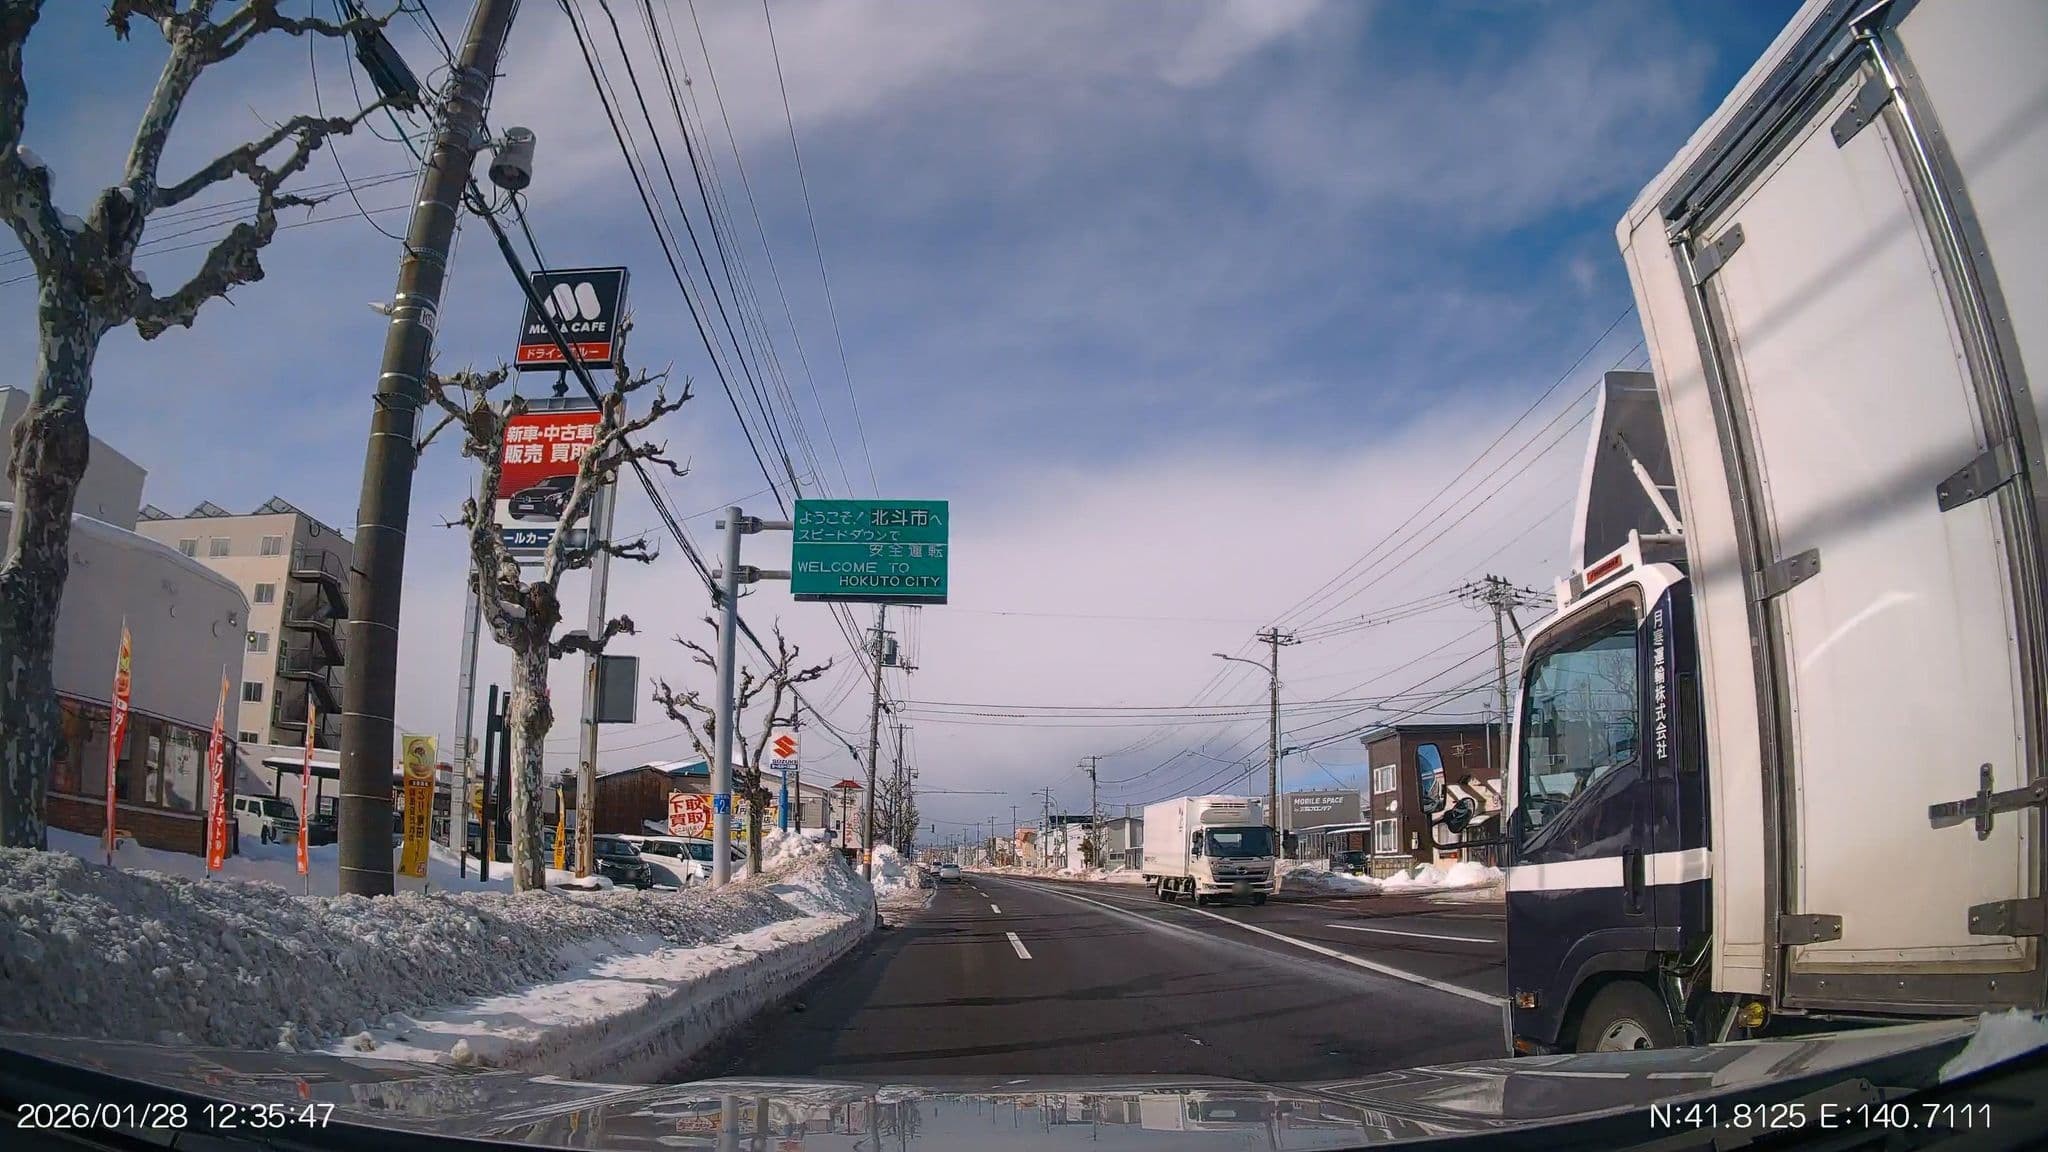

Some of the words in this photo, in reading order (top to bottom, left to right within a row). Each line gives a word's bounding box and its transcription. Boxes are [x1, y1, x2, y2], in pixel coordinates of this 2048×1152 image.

[571, 321, 606, 333] CAFE
[504, 444, 544, 464] 販売
[798, 529, 900, 541] スピードダウンで
[869, 544, 944, 558] 安全運転
[798, 561, 878, 573] WELCOME
[889, 562, 910, 574] TO
[839, 575, 900, 587] HOKUTO
[905, 576, 941, 588] CITY
[670, 799, 702, 813] 下取
[1294, 797, 1321, 805] MOBILE
[1322, 796, 1344, 804] SPACE
[670, 812, 704, 827] 買取
